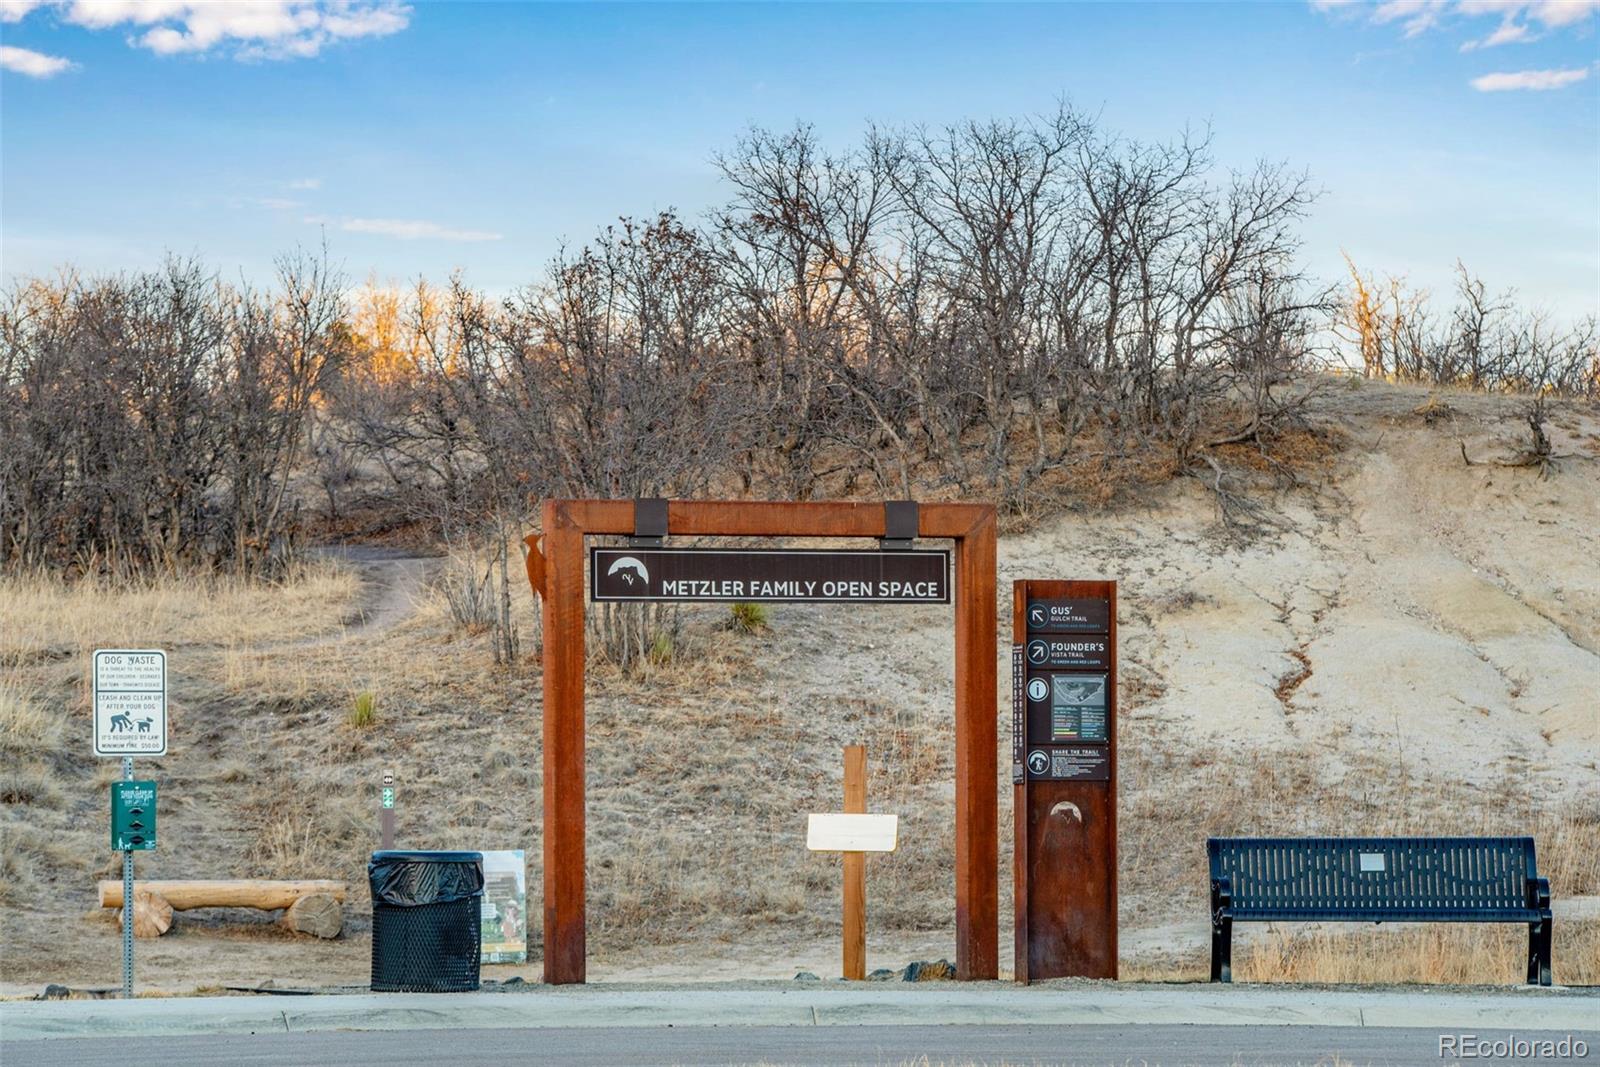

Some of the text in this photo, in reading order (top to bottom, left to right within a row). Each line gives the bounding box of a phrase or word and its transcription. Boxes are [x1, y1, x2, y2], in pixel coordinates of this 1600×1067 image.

[662, 580, 938, 598] METZLER FAMILY OPEN SPACE
[1051, 606, 1073, 615] GUS'
[1051, 642, 1104, 652] FOUNDER'S
[104, 656, 156, 665] DOG WASTE
